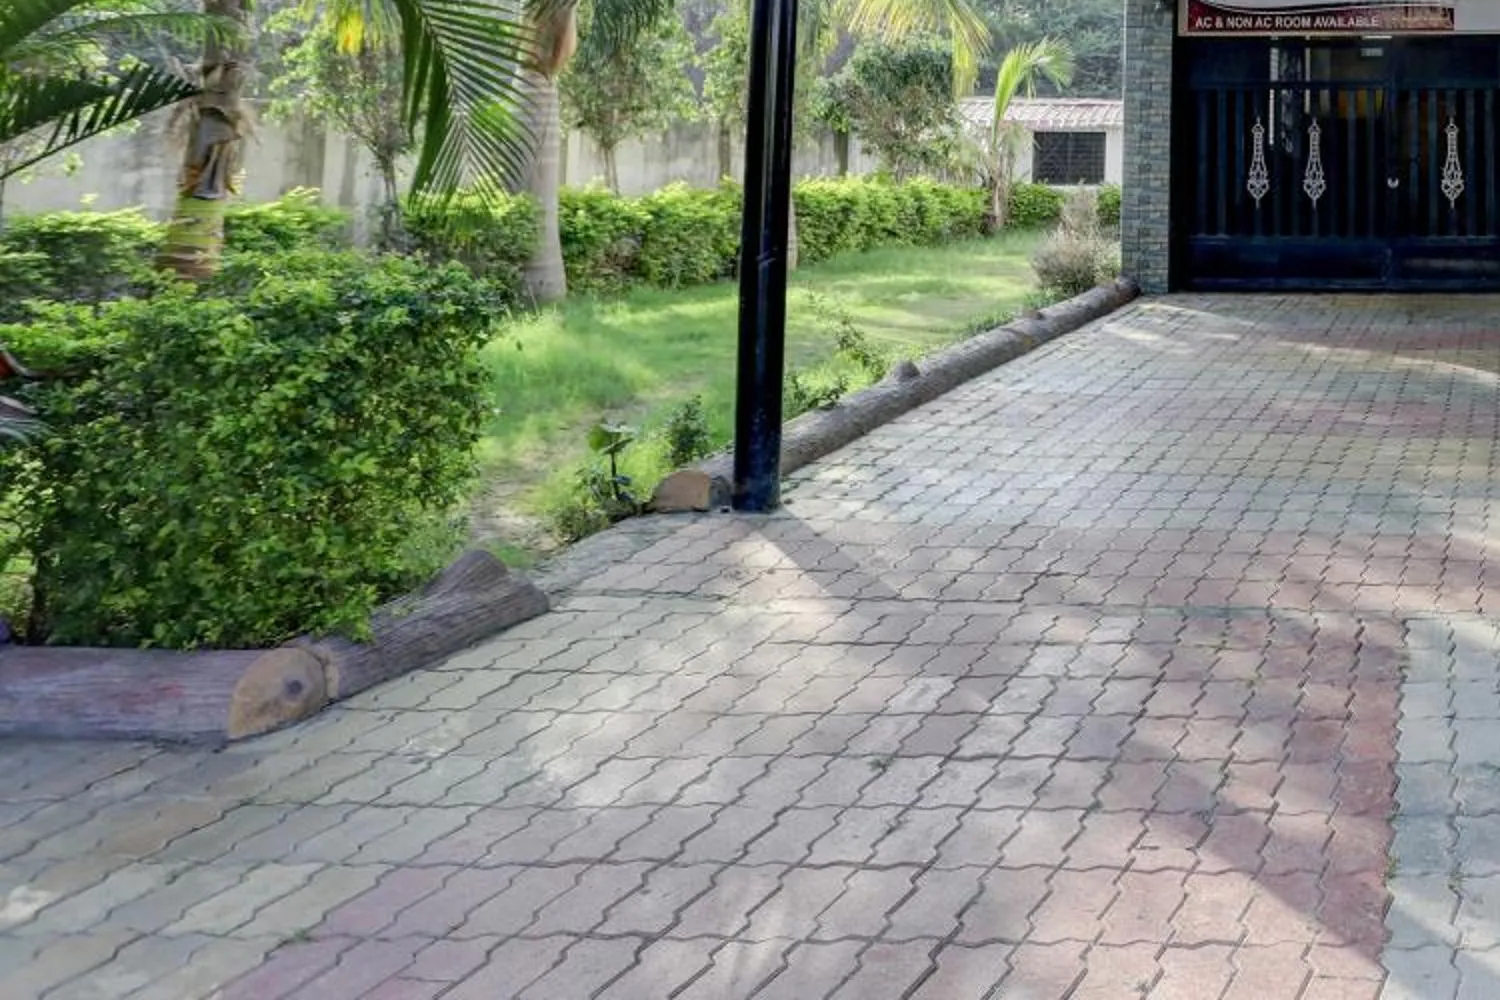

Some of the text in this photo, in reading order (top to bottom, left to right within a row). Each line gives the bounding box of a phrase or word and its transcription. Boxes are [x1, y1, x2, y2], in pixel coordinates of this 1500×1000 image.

[1195, 15, 1380, 29] AC & NON AC ROOM AVAILABLE
